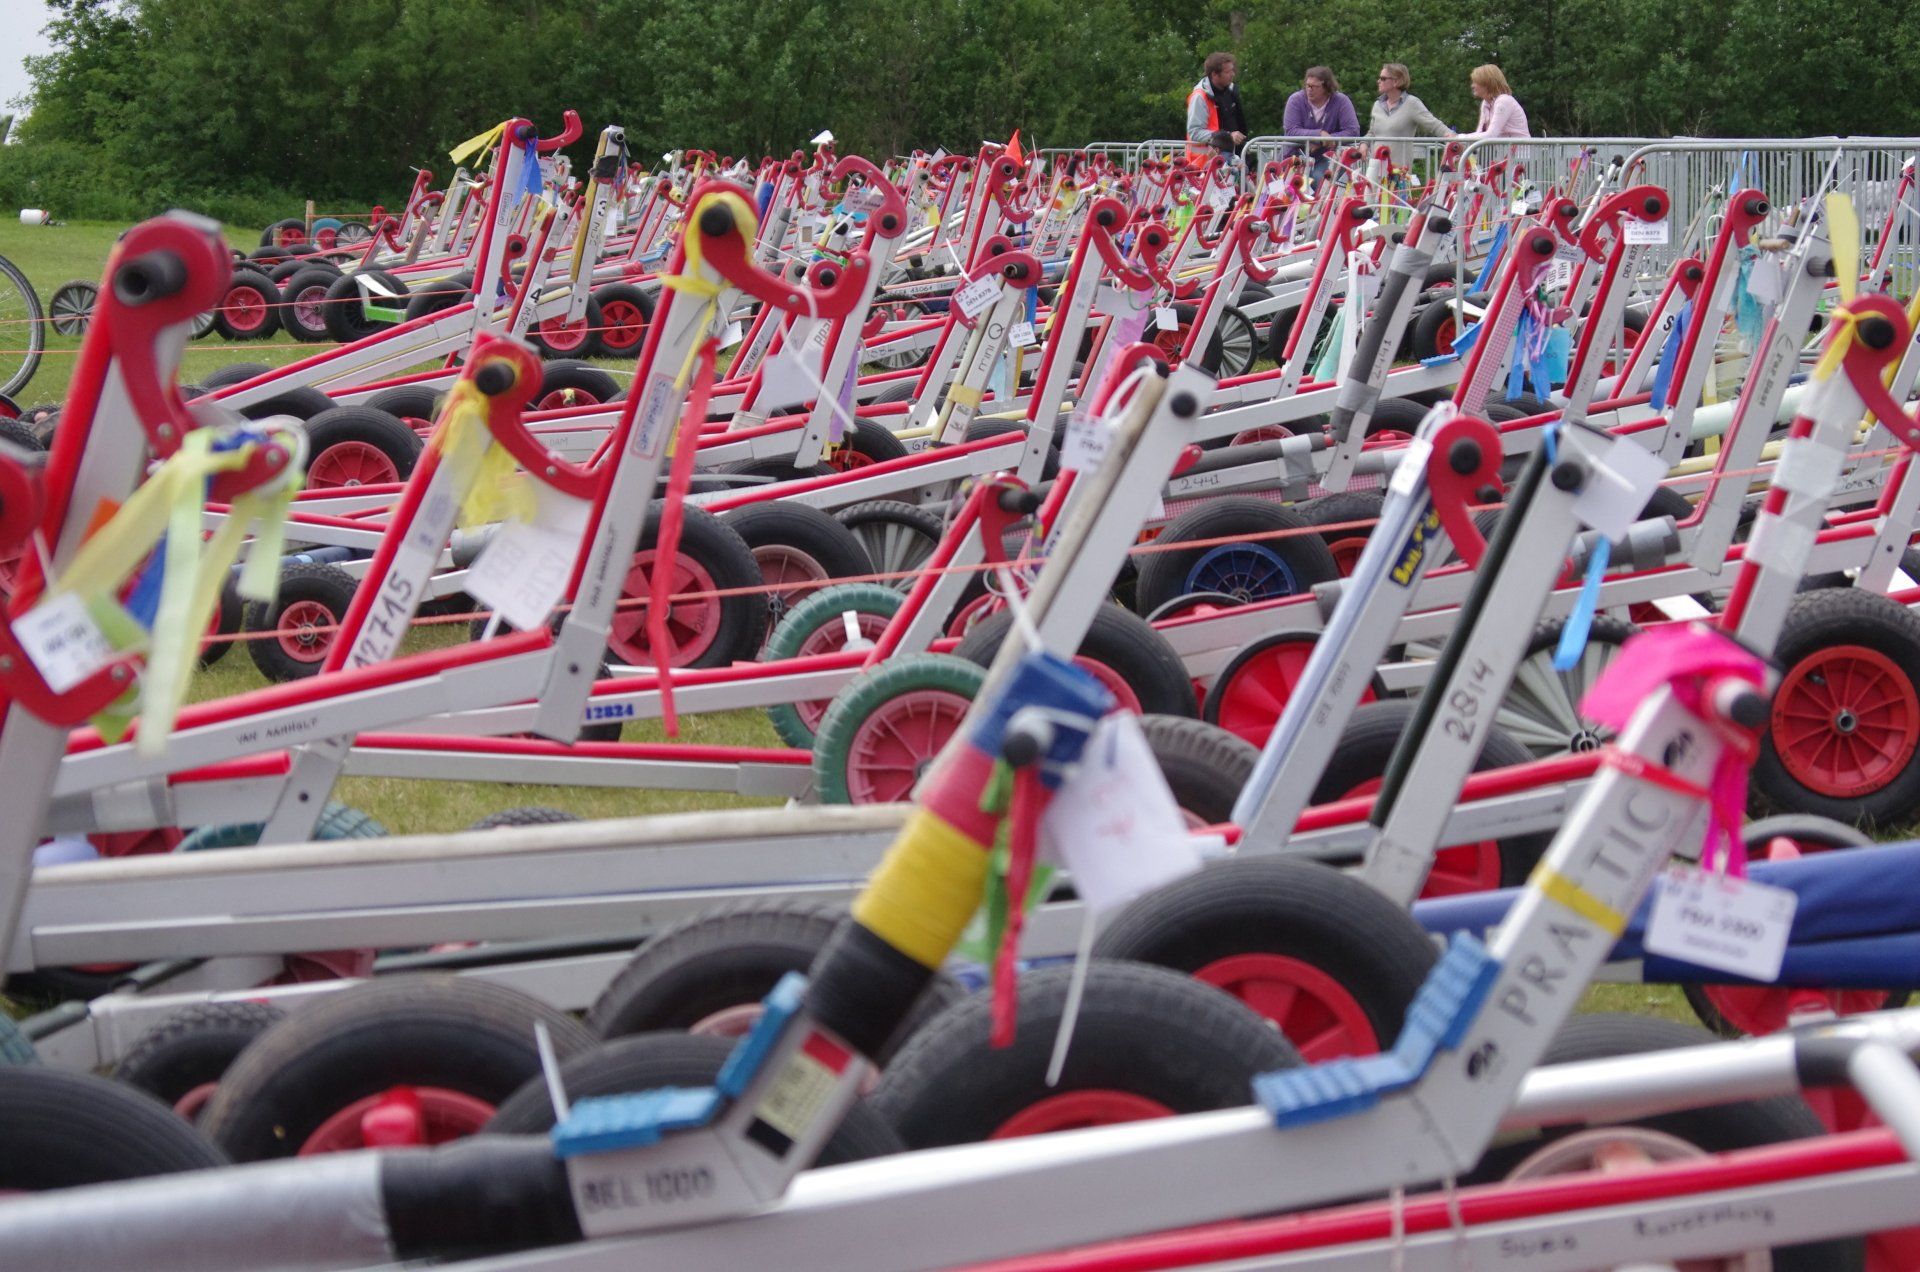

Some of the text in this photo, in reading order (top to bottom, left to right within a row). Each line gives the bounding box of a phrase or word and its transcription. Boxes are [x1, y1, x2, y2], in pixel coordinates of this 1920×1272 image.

[1623, 261, 1633, 279] DEN
[531, 288, 543, 301] 4
[988, 323, 1005, 340] Q
[353, 571, 412, 669] 12715
[1445, 659, 1496, 744] 2814
[586, 703, 634, 720] 12824
